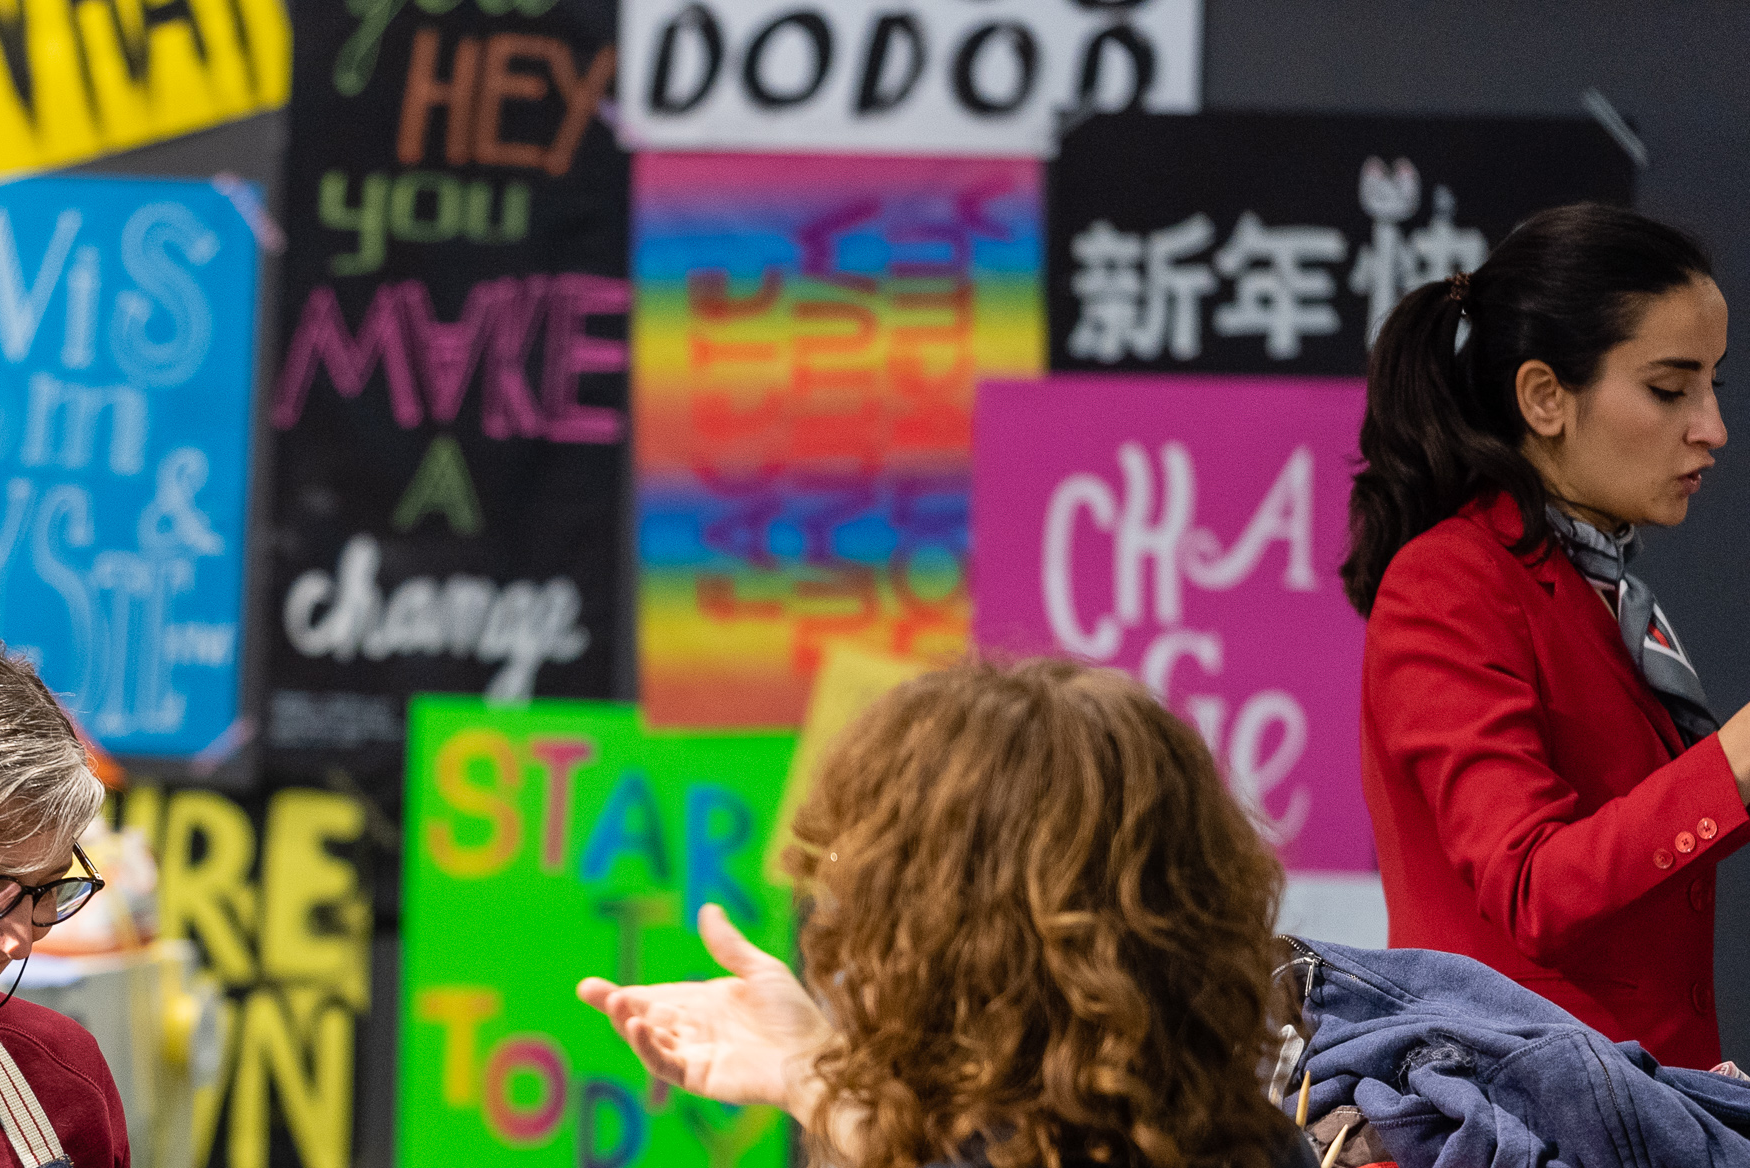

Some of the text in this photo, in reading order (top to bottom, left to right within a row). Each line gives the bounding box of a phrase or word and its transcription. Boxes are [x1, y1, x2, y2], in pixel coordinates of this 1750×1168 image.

[396, 27, 618, 177] HEY
[316, 168, 531, 277] you
[392, 430, 486, 537] A
[282, 532, 592, 709] change
